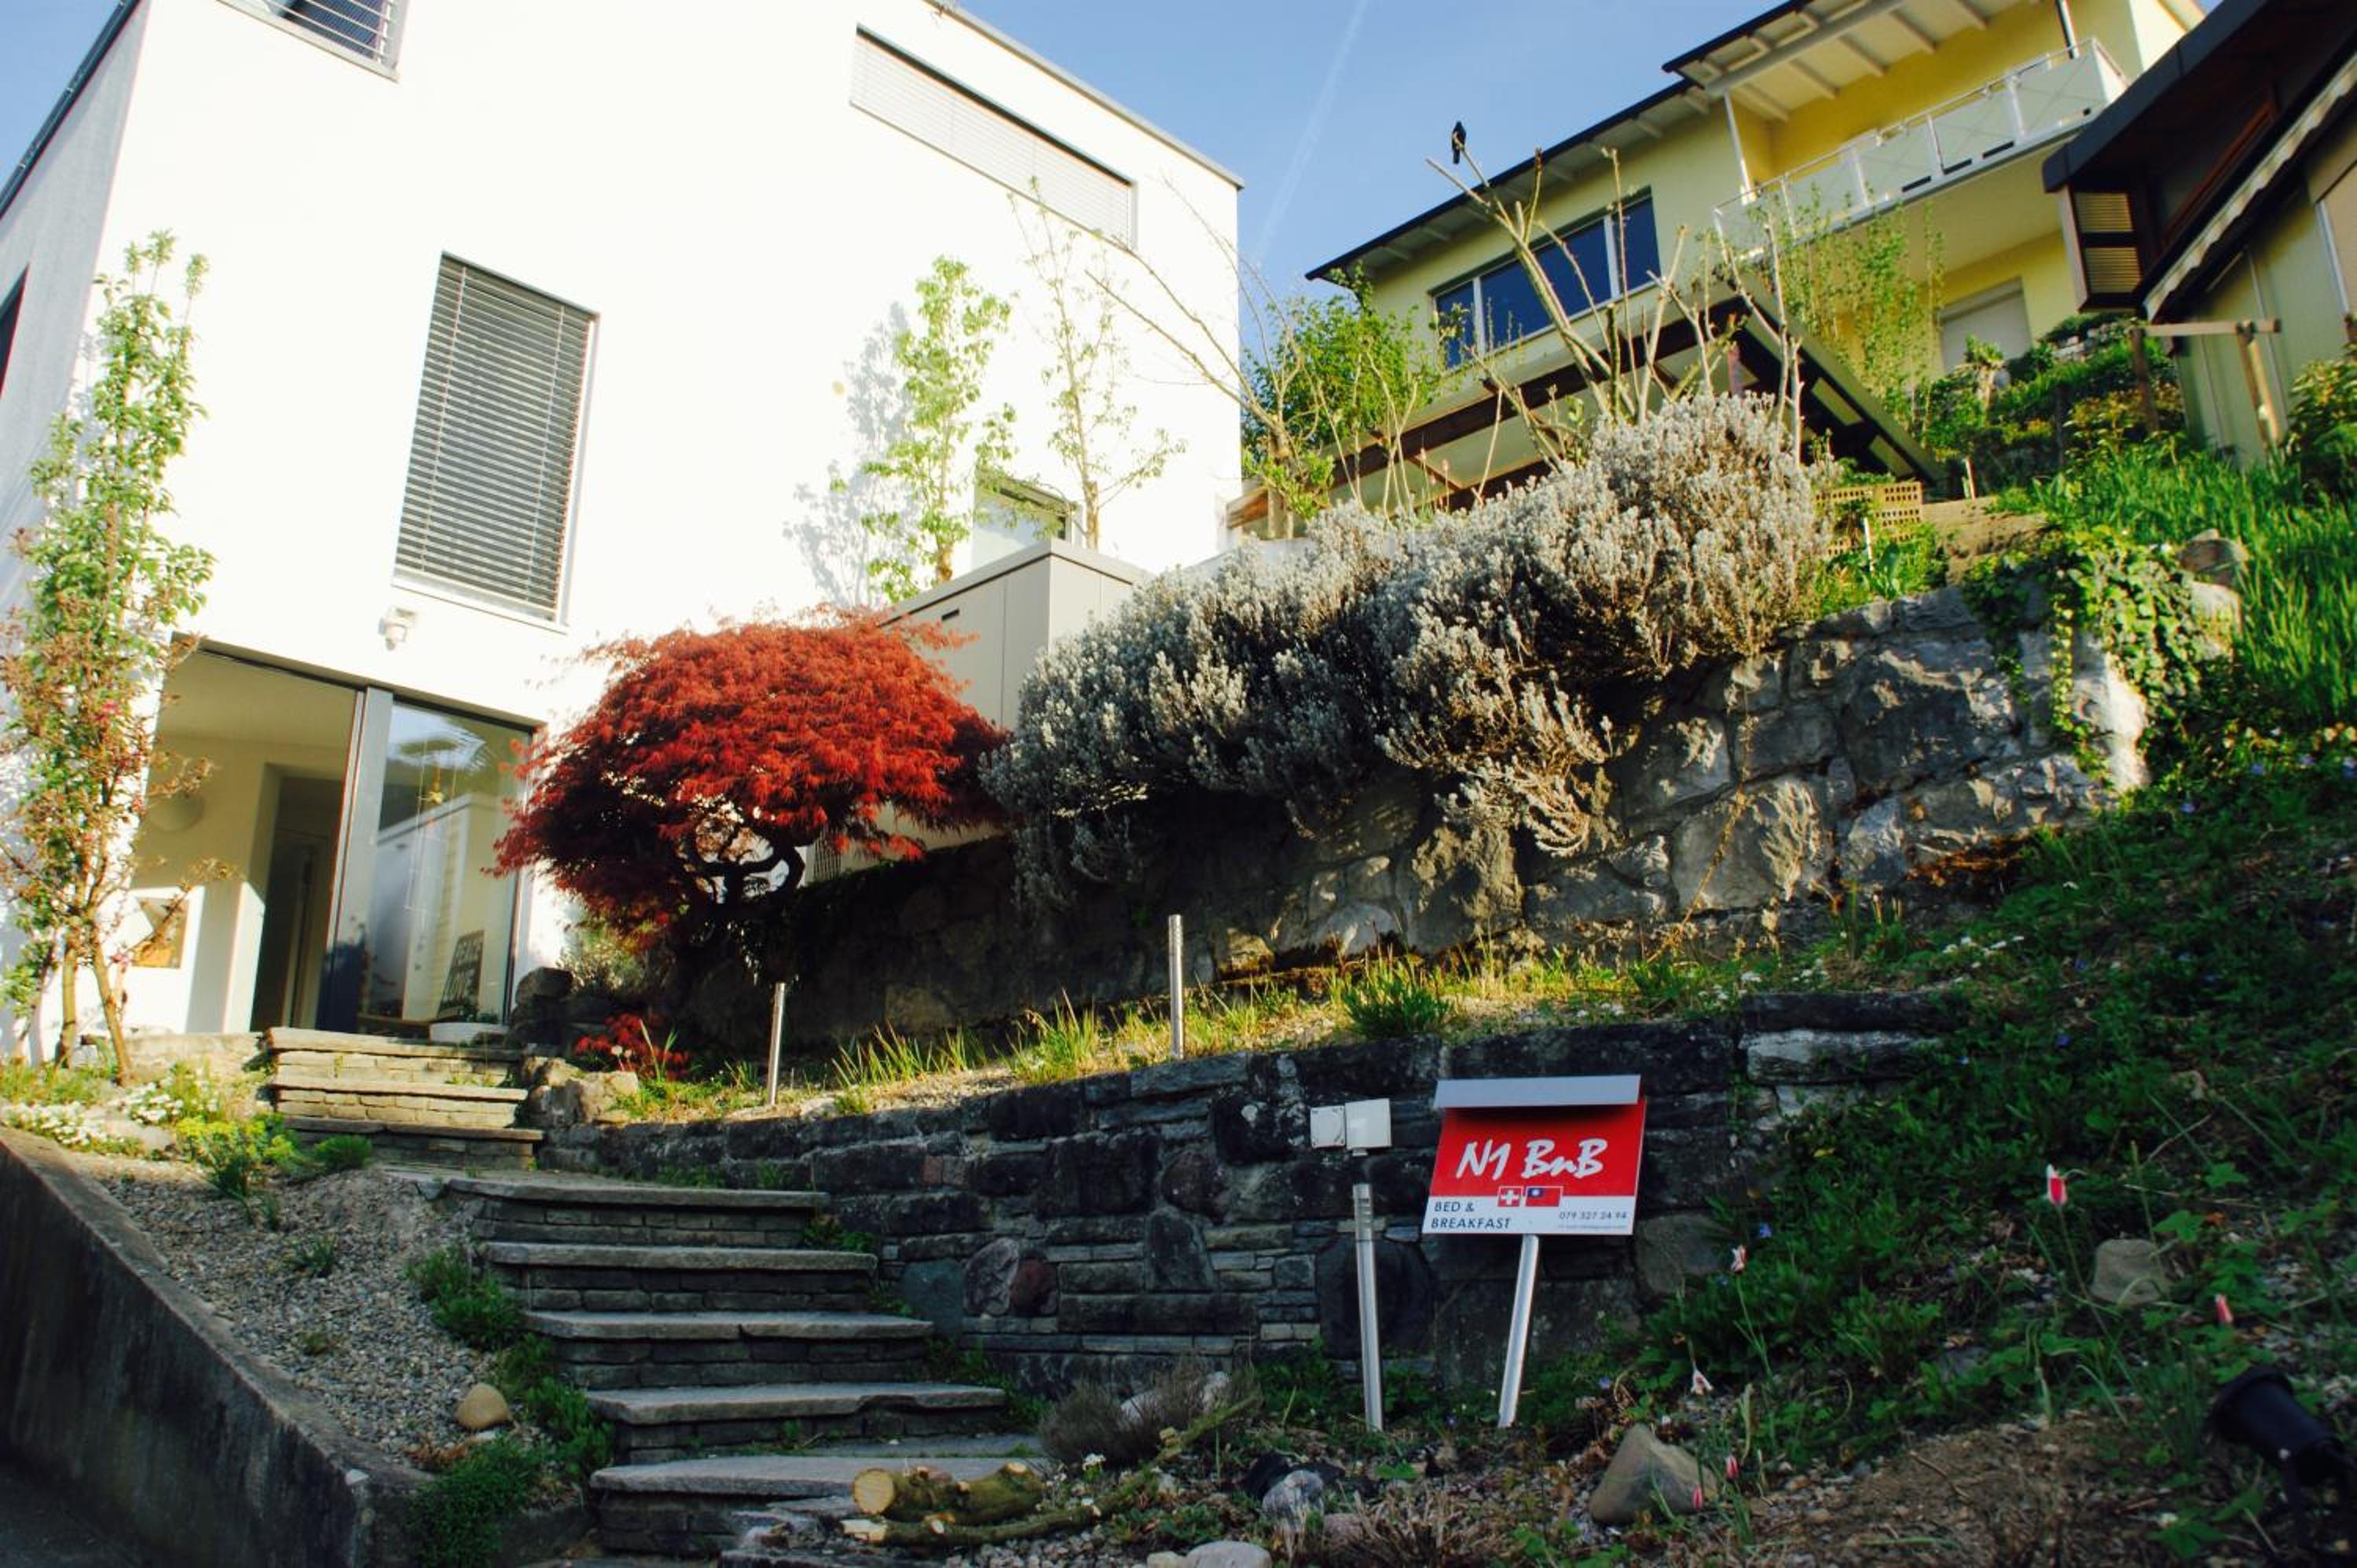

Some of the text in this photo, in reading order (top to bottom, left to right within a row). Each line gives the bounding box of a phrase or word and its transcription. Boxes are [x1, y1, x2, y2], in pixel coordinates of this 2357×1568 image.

[1456, 1138, 1608, 1180] N1 BnB
[1434, 1201, 1475, 1211] BED &
[1431, 1217, 1511, 1229] BREAKFAST
